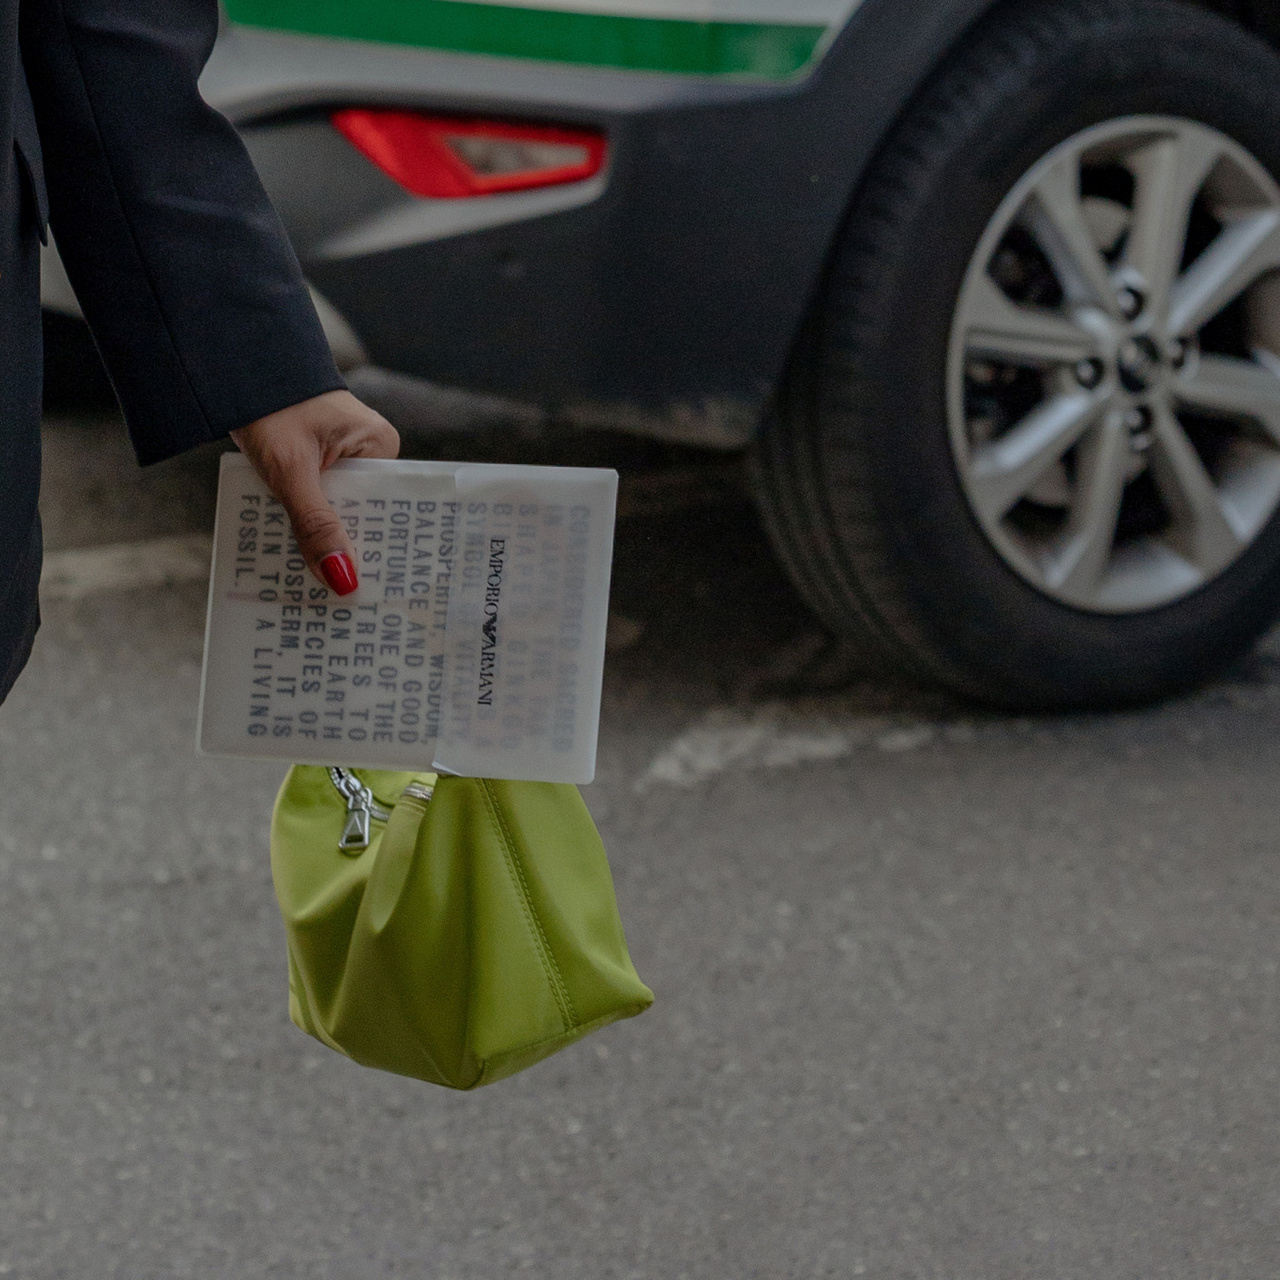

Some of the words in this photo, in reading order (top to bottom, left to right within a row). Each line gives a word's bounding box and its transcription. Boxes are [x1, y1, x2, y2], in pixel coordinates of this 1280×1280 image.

[235, 494, 261, 587] FOSSIL.
[361, 499, 386, 582] FIRST
[384, 500, 412, 604] FORTUNE.
[408, 501, 436, 610] BALANCE
[258, 572, 280, 602] TO
[483, 539, 506, 616] EMPORIO
[256, 618, 276, 631] A
[301, 587, 328, 693] SPECIES
[330, 608, 352, 639] ON
[352, 602, 378, 687] TREES
[380, 614, 402, 656] ONE
[404, 621, 427, 667] AND
[247, 648, 273, 738] LIVING
[276, 676, 296, 698] IT
[323, 654, 350, 740] EARTH
[378, 666, 398, 692] OF
[477, 639, 497, 706] ARMANI
[272, 716, 293, 738] IS
[298, 711, 318, 740] OF
[348, 708, 369, 741] TO
[373, 700, 396, 743] THE
[398, 680, 422, 744] GOOD
